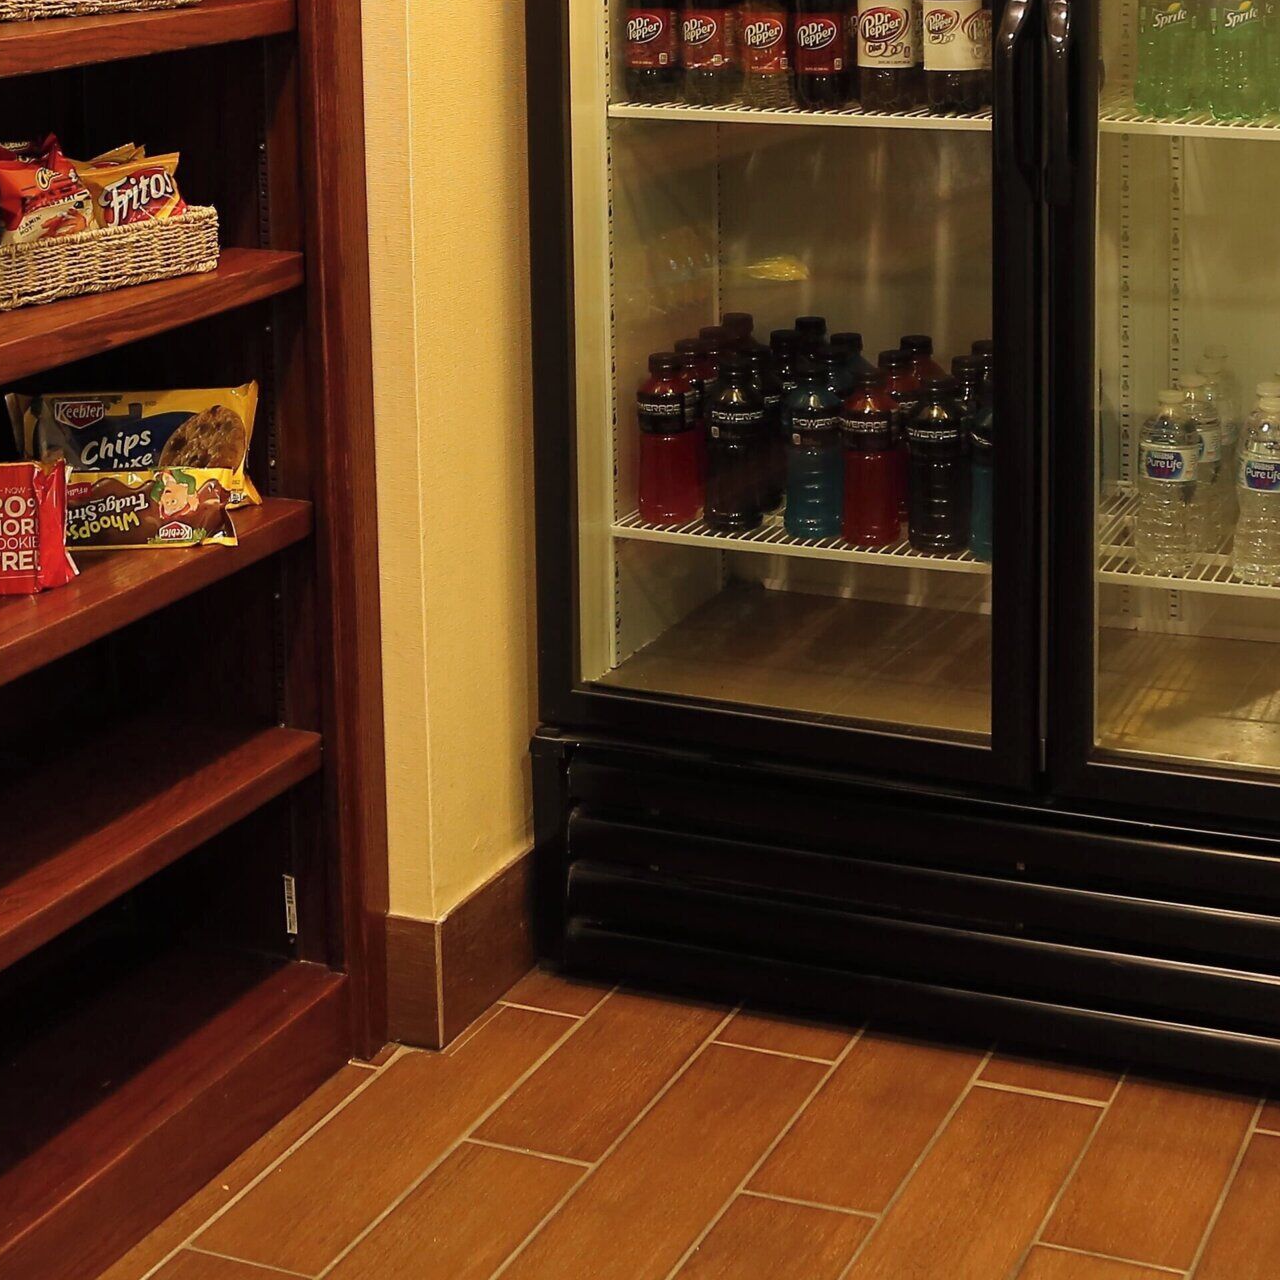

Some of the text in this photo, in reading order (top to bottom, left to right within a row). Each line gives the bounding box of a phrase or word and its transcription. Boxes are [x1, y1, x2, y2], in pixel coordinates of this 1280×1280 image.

[636, 17, 650, 28] Dr
[690, 18, 704, 29] Dr
[756, 22, 771, 32] Dr
[864, 15, 901, 38] Pepper
[875, 12, 892, 25] Dr
[1153, 10, 1187, 31] Sprite
[1224, 8, 1259, 30] Sprite
[627, 18, 660, 42] Pepper
[683, 20, 714, 42] Pepper
[745, 24, 781, 47] Pepper
[798, 25, 834, 47] Pepper
[809, 22, 824, 33] Dr
[99, 171, 174, 225] Fritos
[58, 404, 103, 419] Keebler
[81, 430, 151, 464] Chips
[1147, 459, 1183, 471] Pure Life
[1246, 469, 1266, 479] Pure
[4, 487, 25, 495] NOW
[97, 493, 149, 512] Fudge
[160, 524, 192, 537] Keebler
